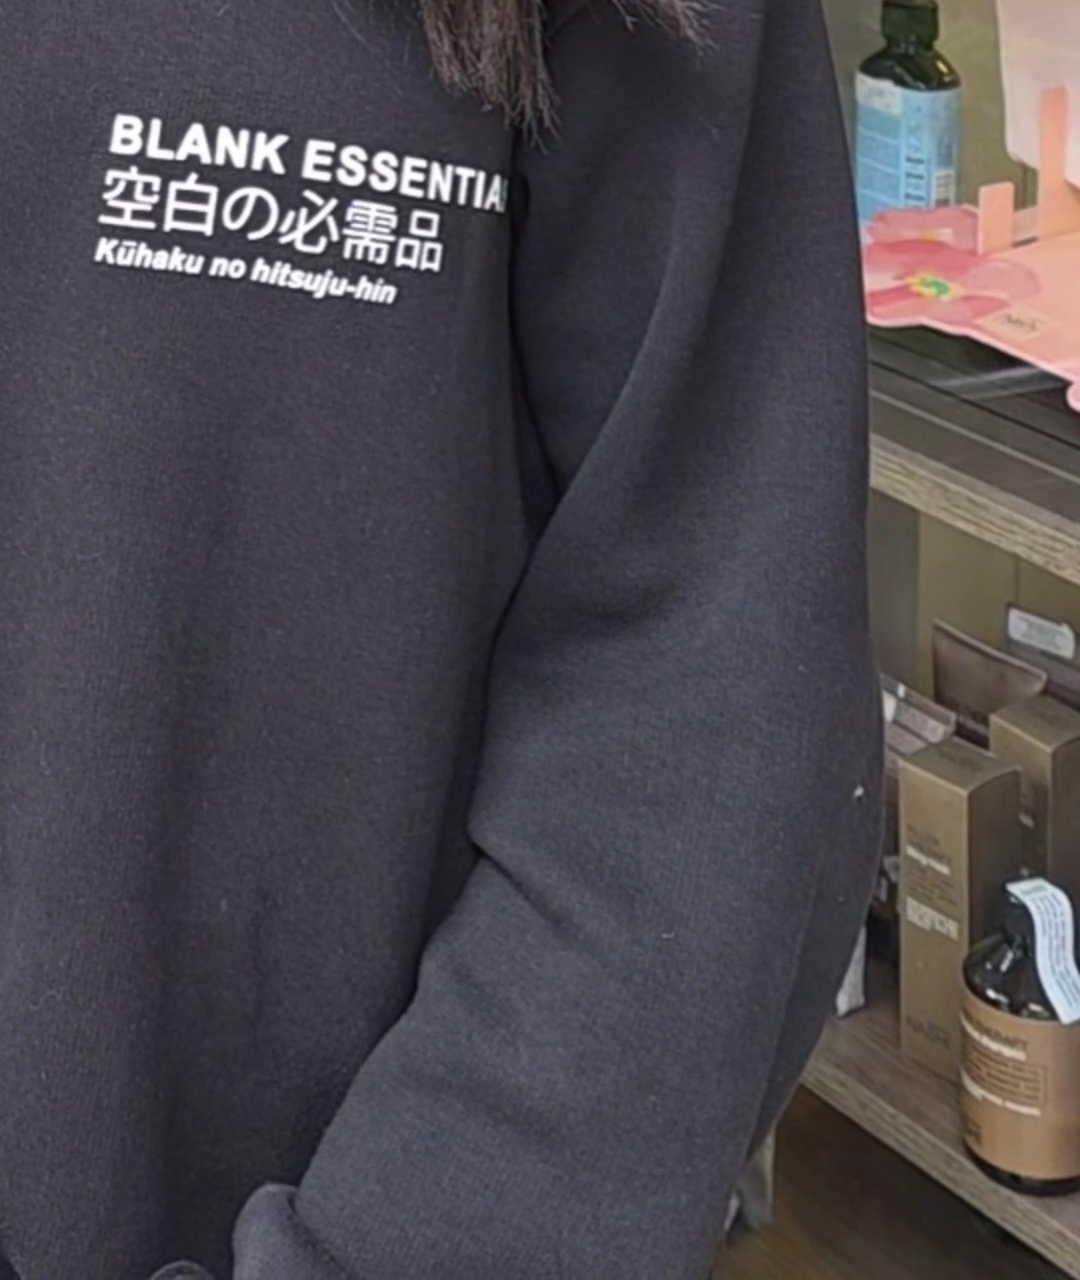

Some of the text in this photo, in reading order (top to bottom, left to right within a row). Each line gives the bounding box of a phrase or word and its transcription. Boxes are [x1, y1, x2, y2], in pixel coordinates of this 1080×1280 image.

[109, 113, 290, 175] BLANK
[97, 164, 443, 273] 空白の必需品
[93, 236, 398, 305] Kūhaku no hitsuju-hin
